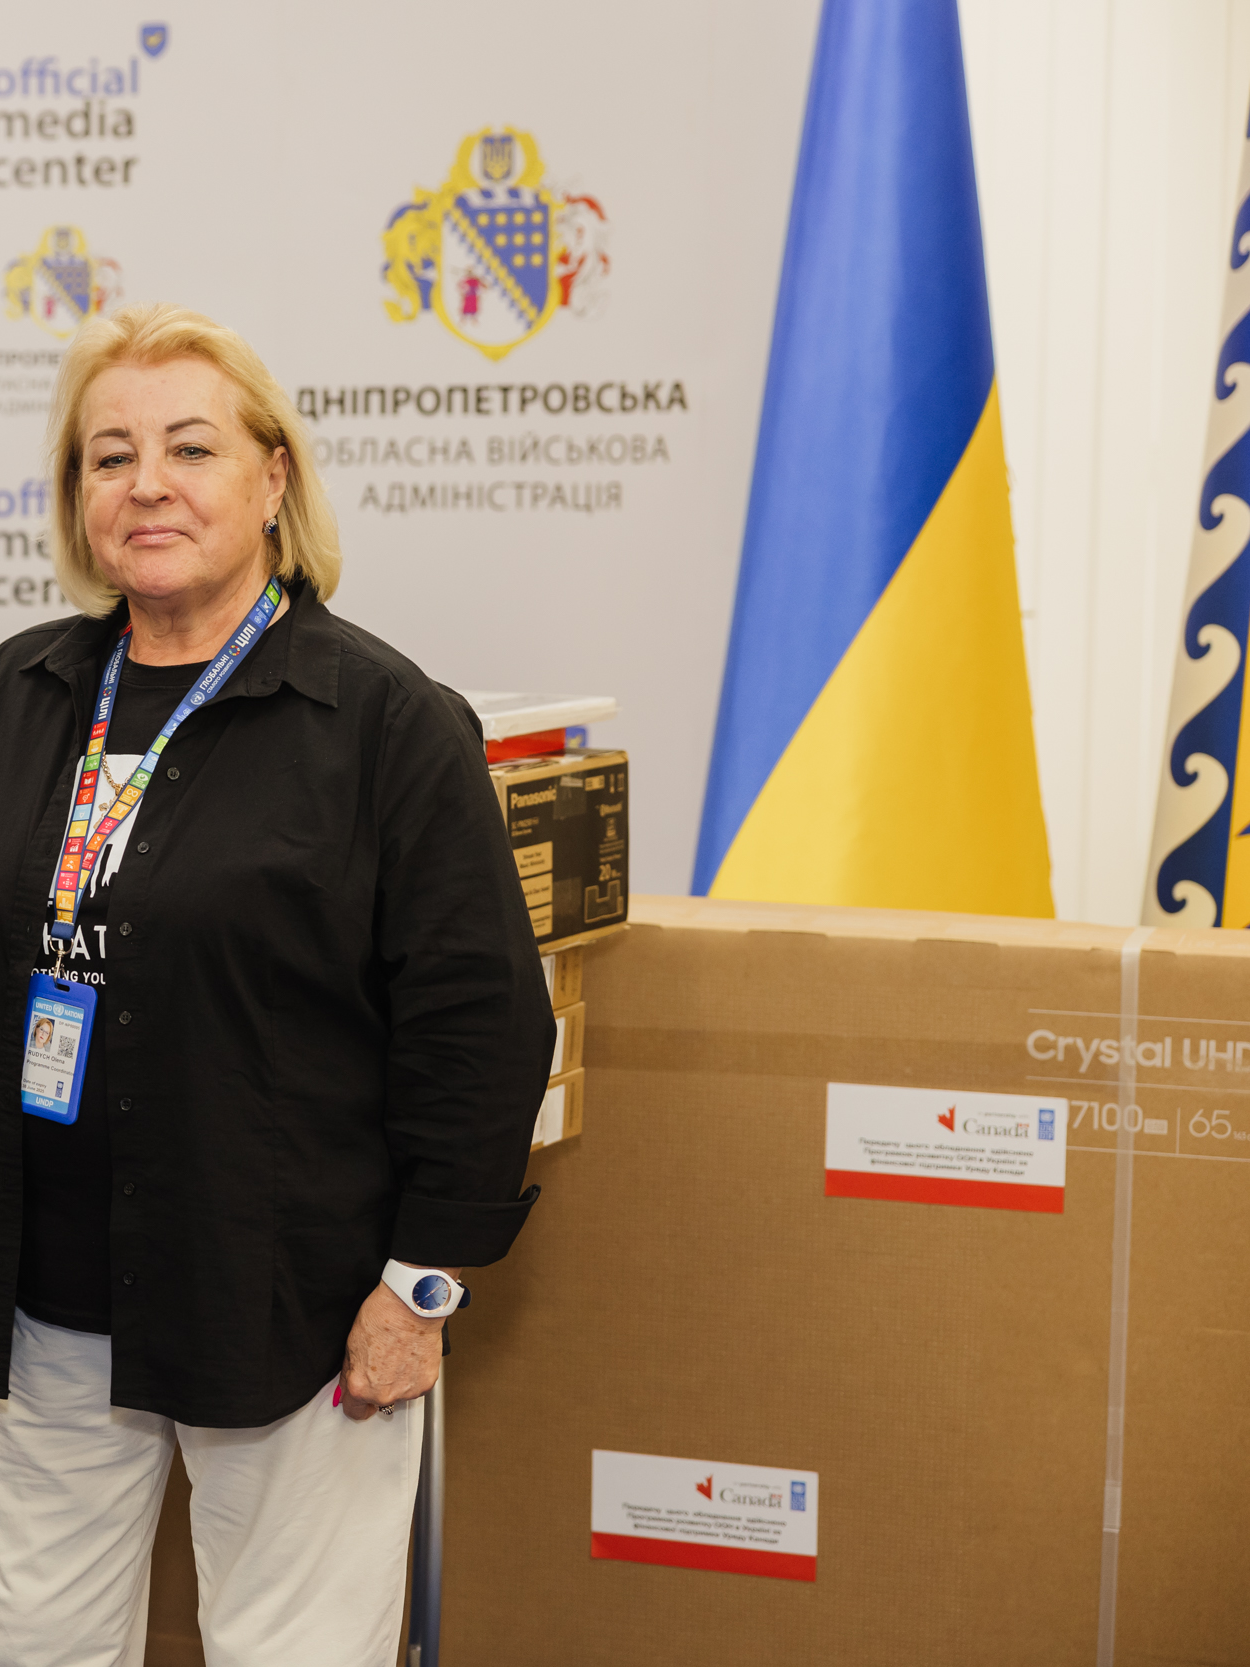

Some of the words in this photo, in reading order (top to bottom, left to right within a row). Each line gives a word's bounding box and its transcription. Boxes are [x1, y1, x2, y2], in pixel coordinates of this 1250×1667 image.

[297, 381, 689, 420] ДНІПРОПЕТРОВСЬКА
[485, 431, 671, 467] ВІЙСЬКОВА
[359, 480, 624, 516] АДМІНІСТРАЦІЯ
[235, 623, 257, 648] ЦІЛІ
[511, 784, 557, 809] Panasonic
[35, 1002, 52, 1012] UNITED
[64, 1008, 84, 1020] NATIONS
[1026, 1029, 1172, 1073] Crystal
[35, 1097, 54, 1107] UNDP
[963, 1118, 1029, 1138] Canada
[1188, 1108, 1232, 1139] 65
